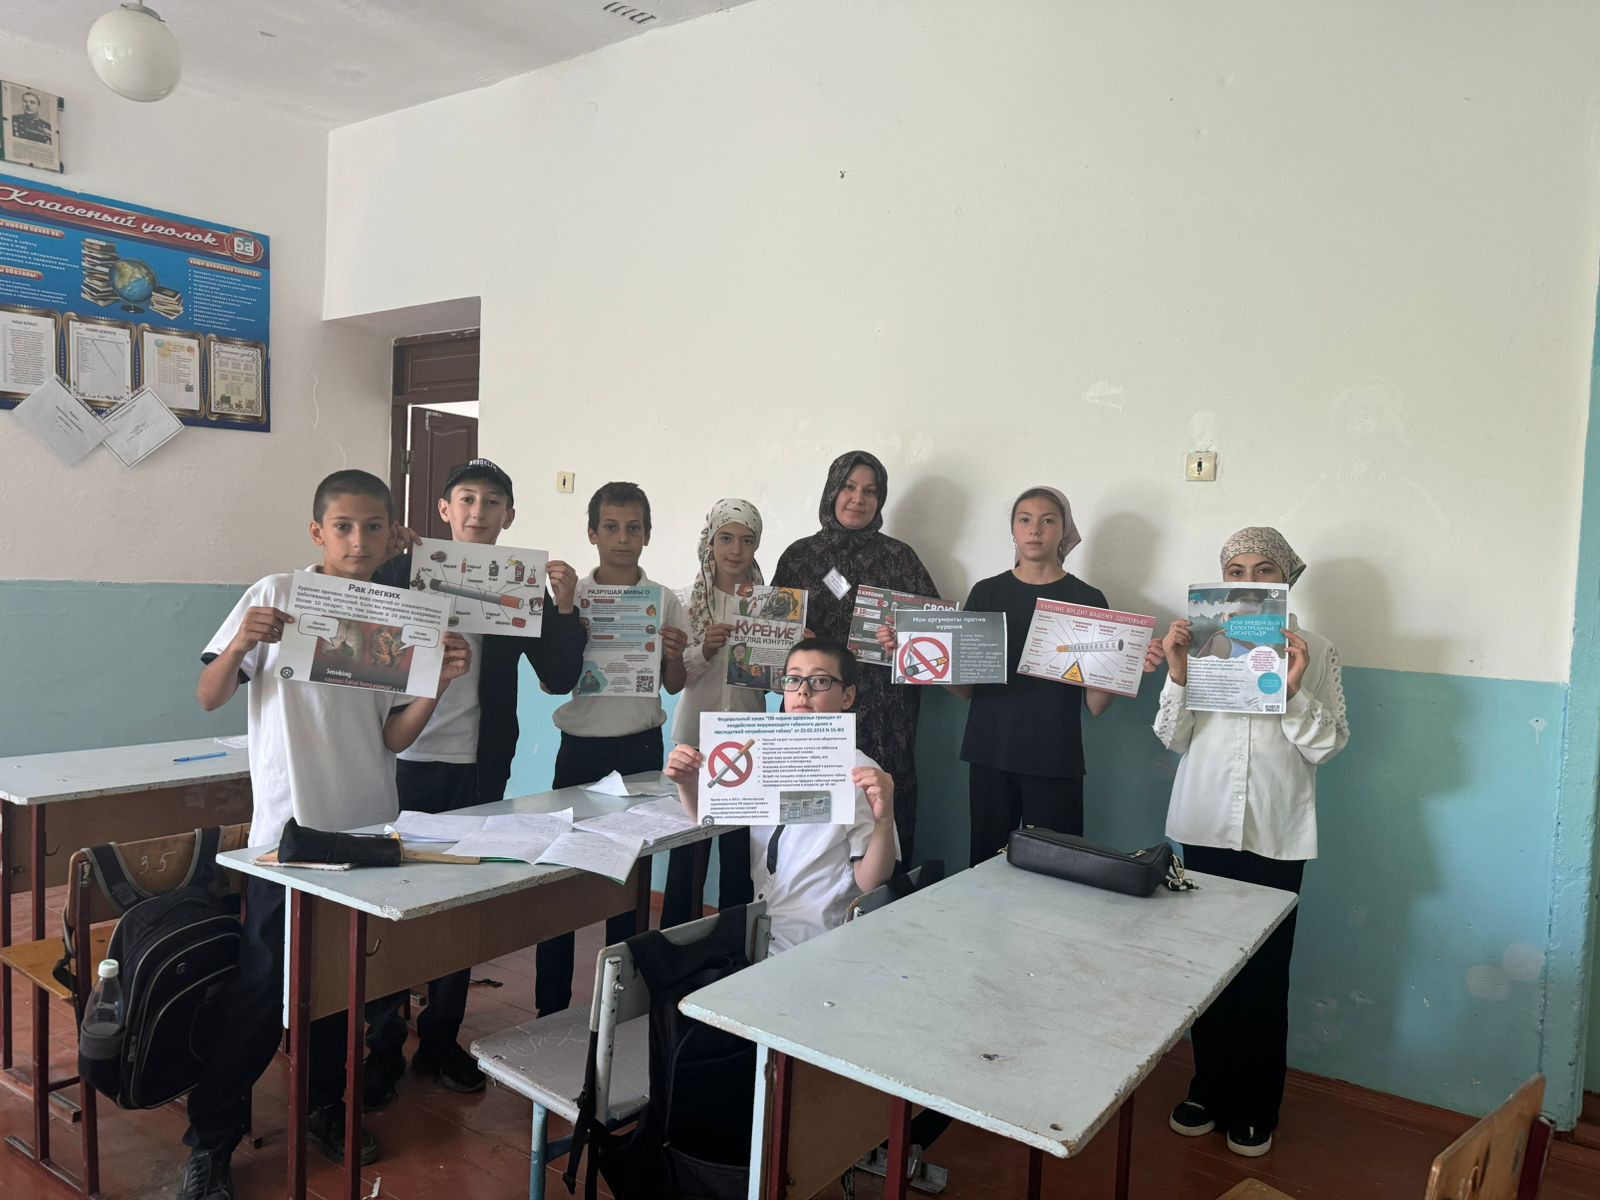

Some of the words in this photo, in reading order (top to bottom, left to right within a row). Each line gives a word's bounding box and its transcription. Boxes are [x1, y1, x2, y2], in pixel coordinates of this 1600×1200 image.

[0, 186, 137, 228] Классный
[141, 222, 220, 246] уголок
[348, 583, 366, 595] Рак
[367, 587, 401, 600] легких
[963, 616, 986, 624] против
[1040, 604, 1064, 612] КУРЕНИЕ
[1066, 608, 1088, 616] ВРЕДИТ
[1089, 611, 1114, 620] ВАШЕМУ
[734, 619, 797, 640] КУРЕНИЕ
[734, 635, 761, 644] ВЗГЛЯД
[762, 637, 794, 646] ИЗНУТРИ
[325, 668, 352, 678] Smoking
